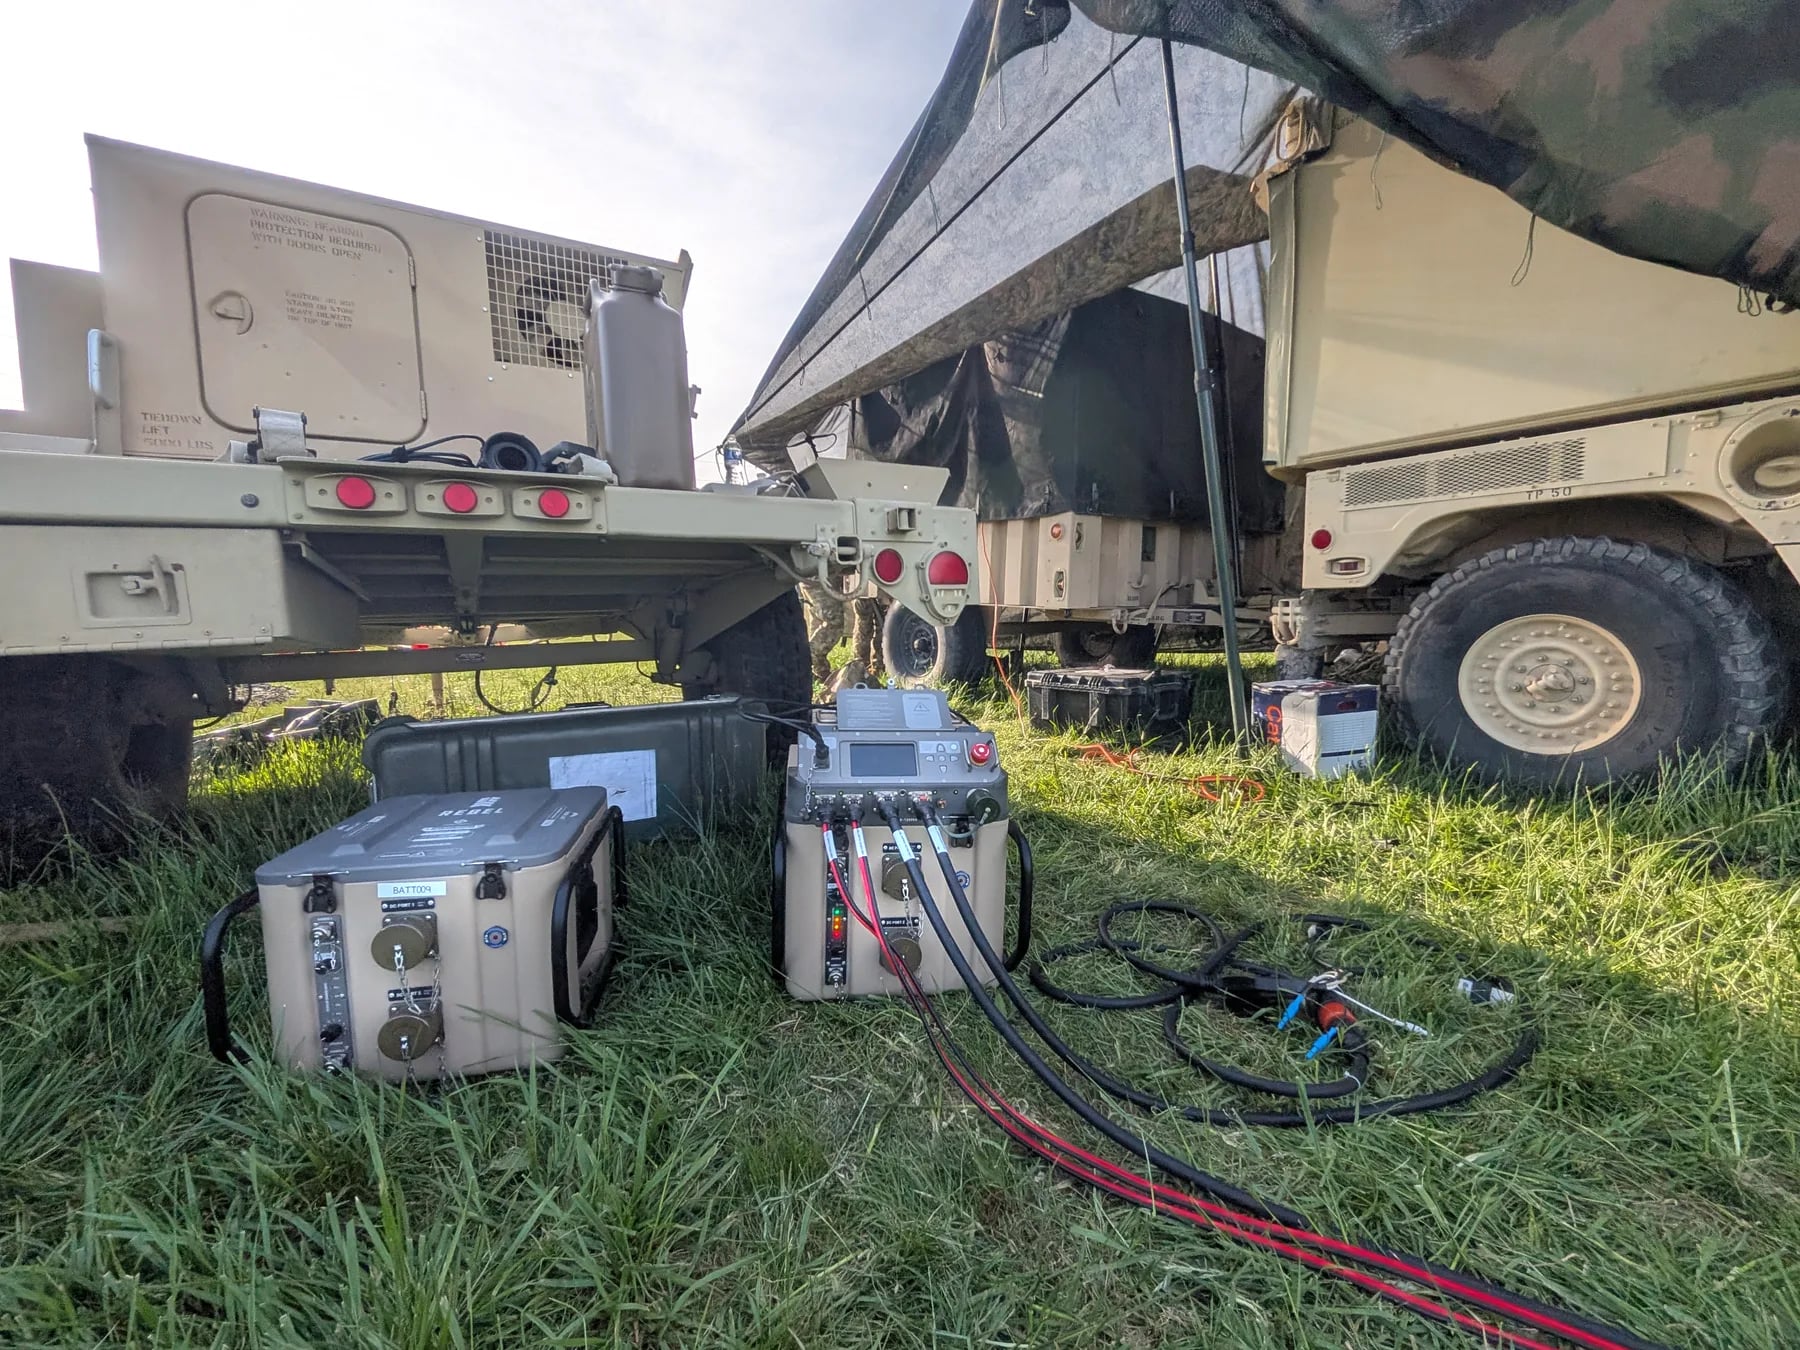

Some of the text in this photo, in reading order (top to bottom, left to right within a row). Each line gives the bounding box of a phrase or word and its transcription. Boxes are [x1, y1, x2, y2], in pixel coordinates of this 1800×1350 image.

[250, 219, 382, 254] PROTECTION REQUIRED
[251, 231, 362, 261] WITH DOORS OPEN
[141, 412, 202, 424] TIEDOWN
[142, 425, 169, 435] LIFT
[187, 440, 213, 450] LBS
[1526, 487, 1572, 500] TP 50
[438, 807, 503, 817] REBEL
[392, 885, 432, 895] BATT009
